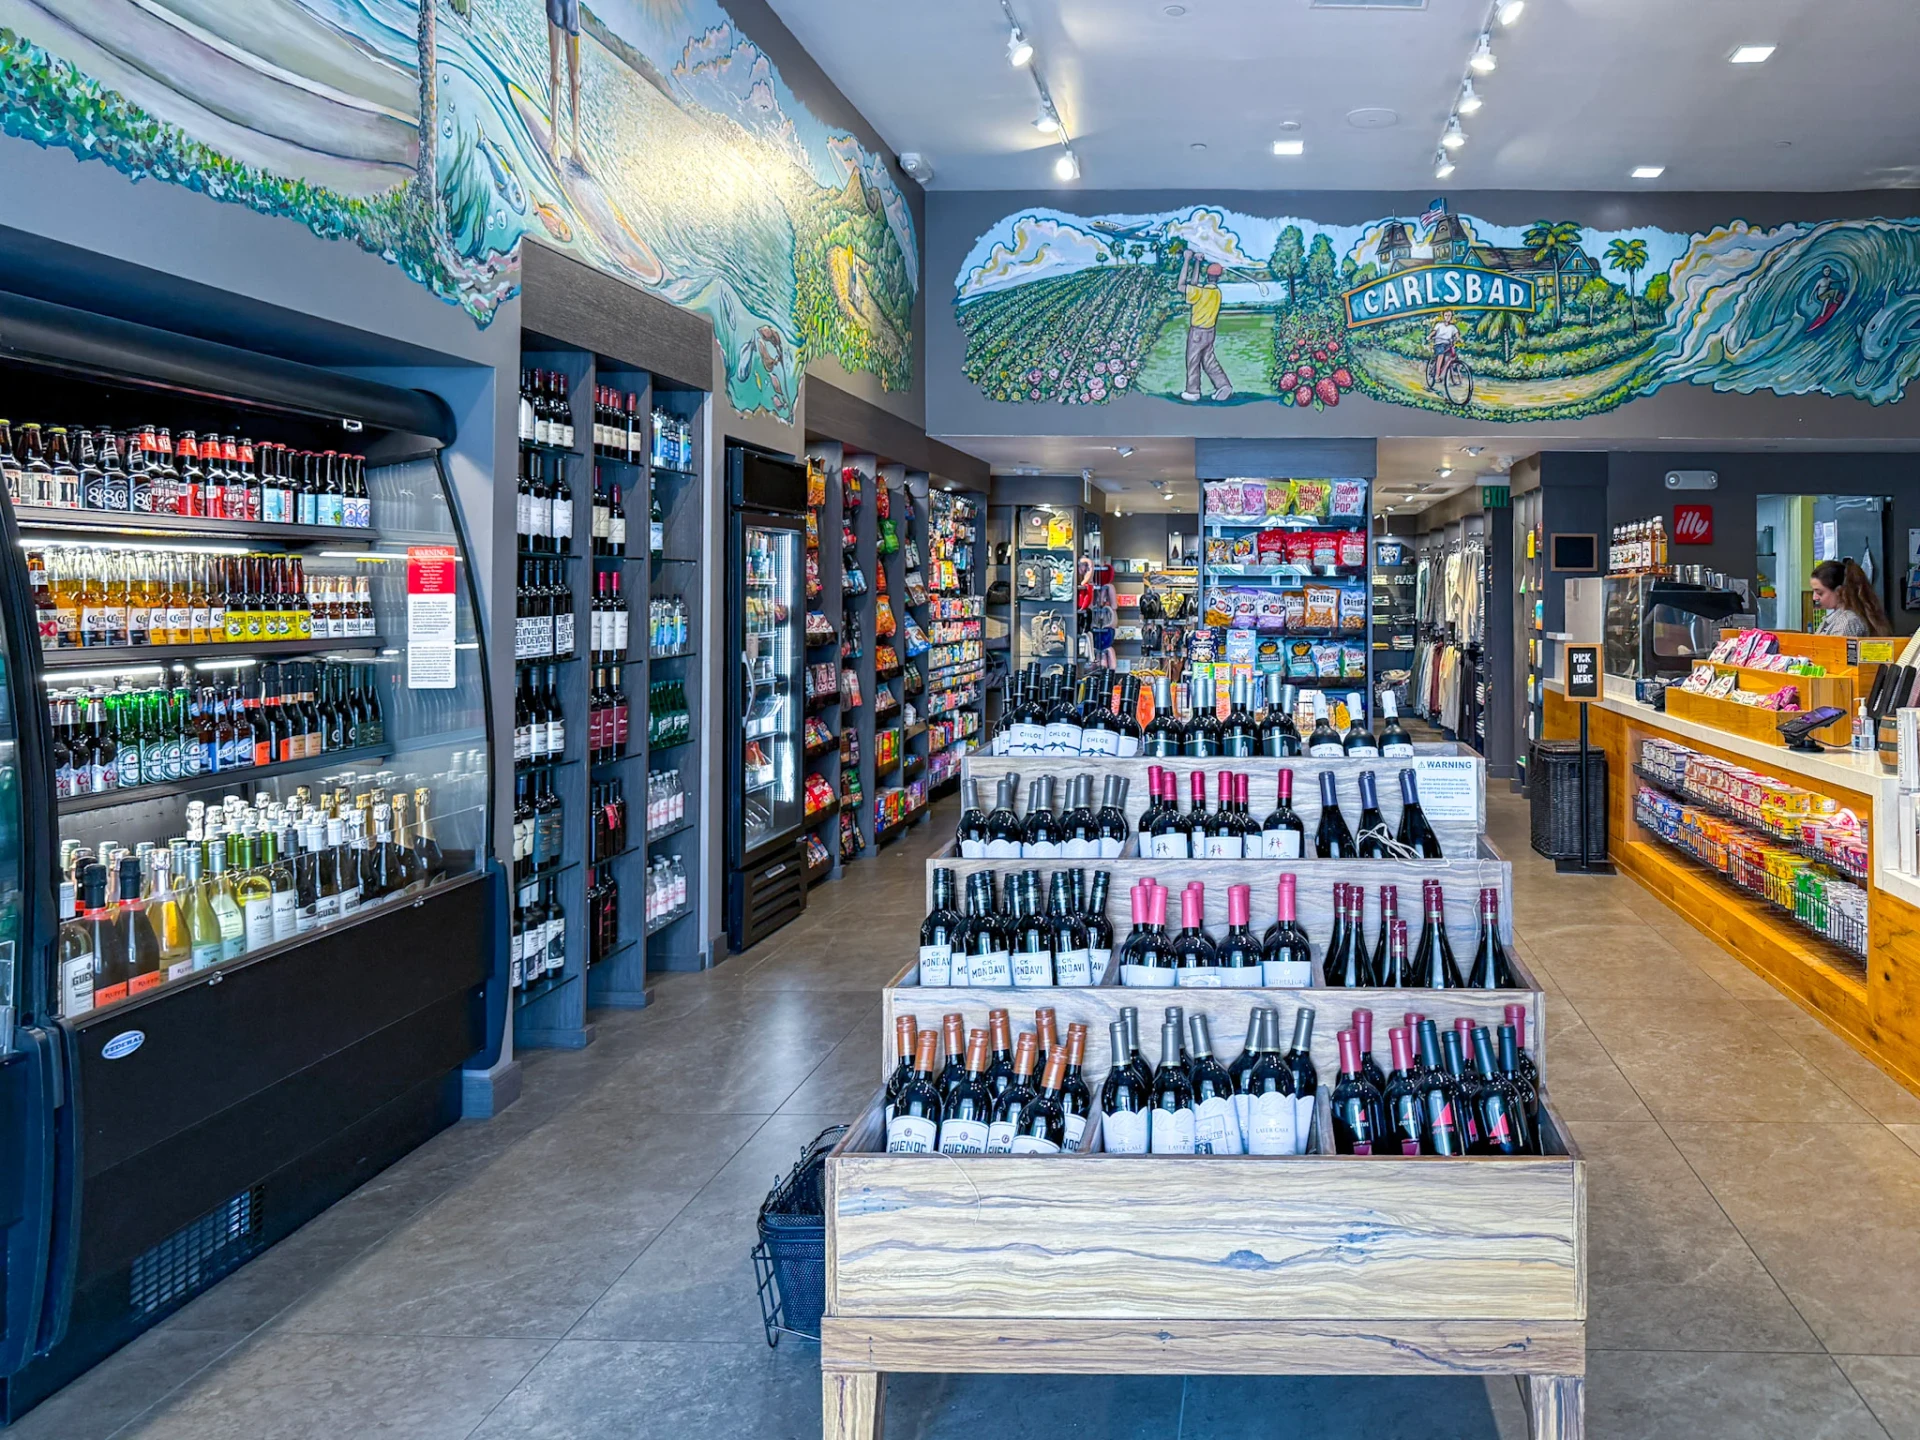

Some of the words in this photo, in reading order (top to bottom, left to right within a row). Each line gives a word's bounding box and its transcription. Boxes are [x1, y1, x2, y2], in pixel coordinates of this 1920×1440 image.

[1364, 271, 1524, 314] CARLSBAD
[1267, 488, 1286, 497] BOOM
[1299, 484, 1323, 494] BOOM
[1336, 485, 1358, 494] BOOM
[1335, 495, 1358, 503] CHICKA
[1482, 486, 1508, 506] EXIT
[1267, 502, 1280, 510] POP
[1300, 500, 1316, 510] POP
[1334, 503, 1351, 513] POP
[1676, 511, 1709, 540] illy
[1309, 595, 1334, 603] CRETORS
[1573, 653, 1592, 663] PICK
[1577, 664, 1588, 673] UP
[1573, 675, 1593, 684] HERE
[1427, 761, 1472, 769] WARNING
[971, 964, 1006, 979] MONDAVI
[104, 1035, 143, 1054] FEDERAL
